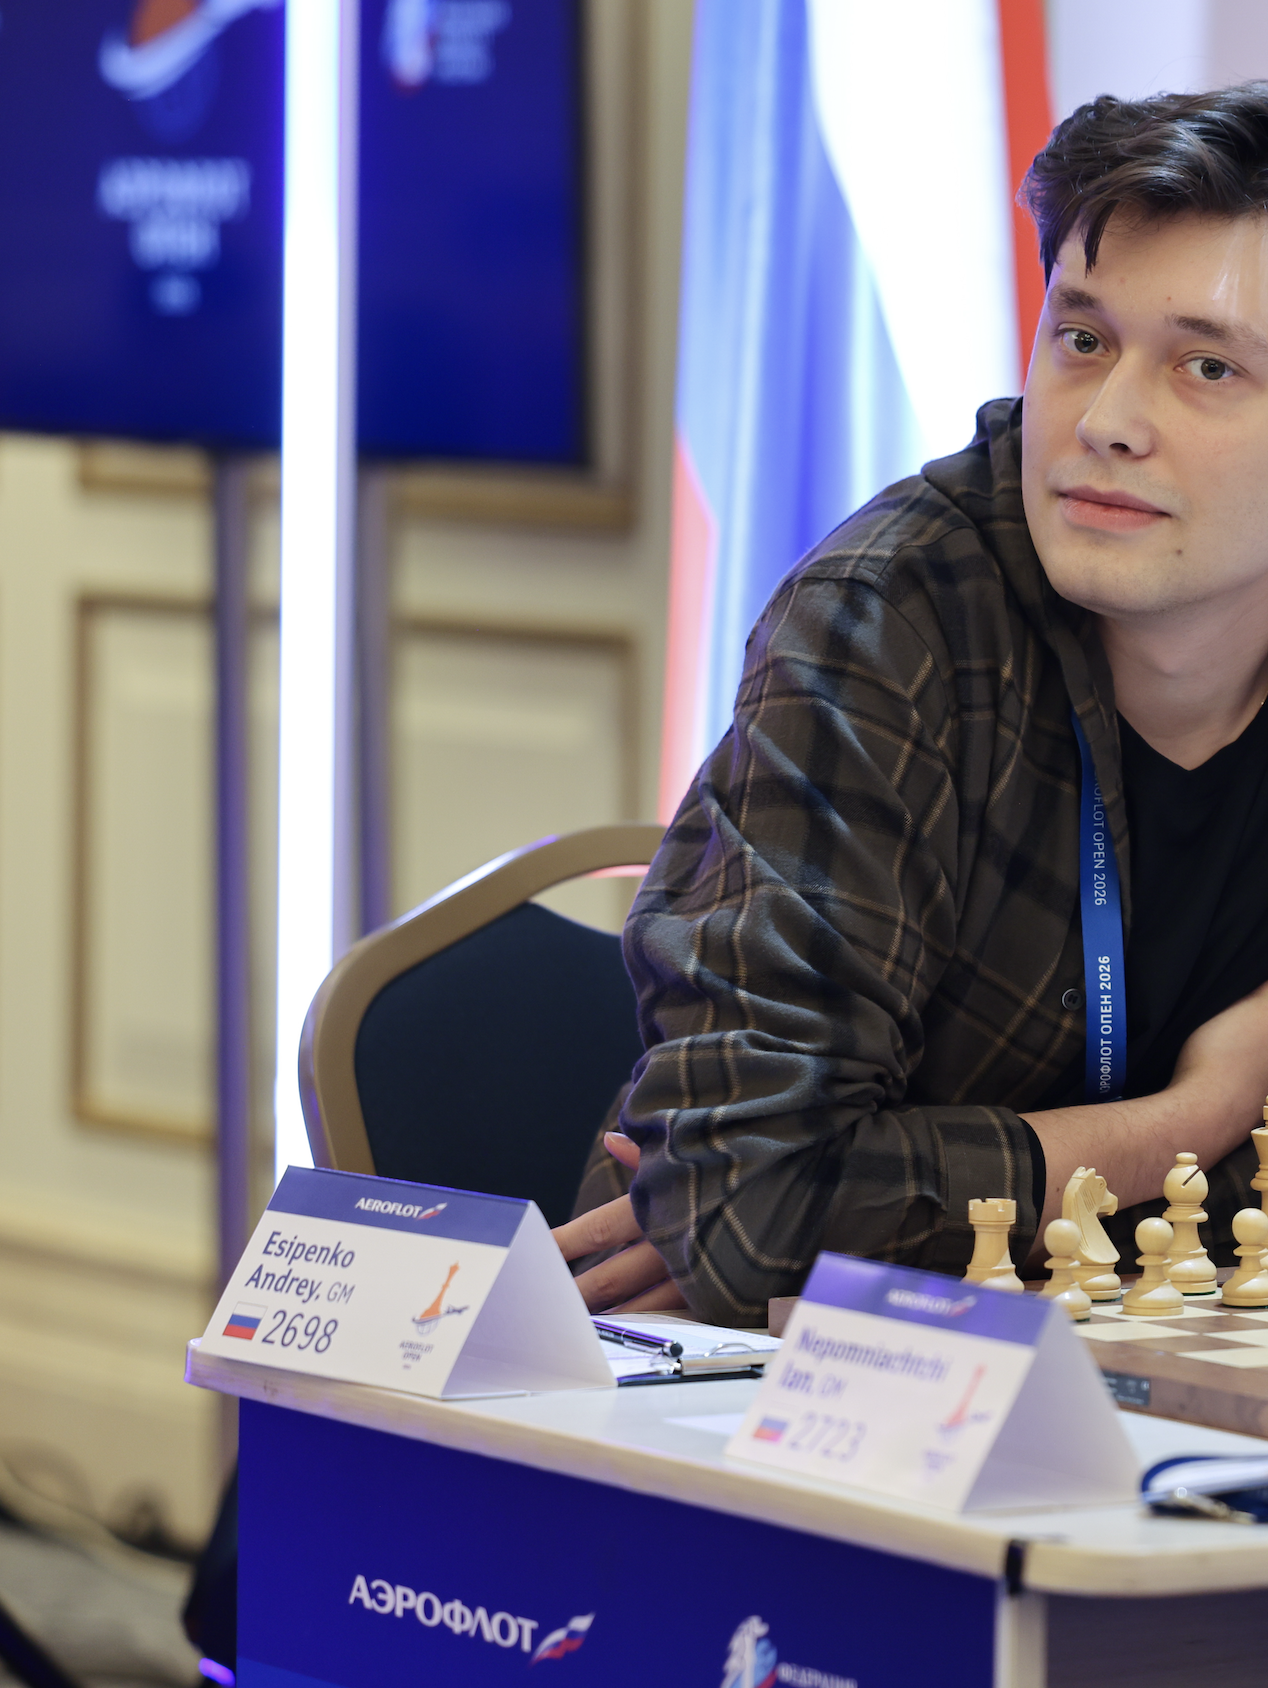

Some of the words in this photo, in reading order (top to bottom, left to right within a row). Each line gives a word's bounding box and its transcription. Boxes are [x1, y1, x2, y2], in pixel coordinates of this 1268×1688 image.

[1093, 832, 1105, 868] OPEN
[1094, 873, 1107, 906] 2026
[1098, 956, 1112, 990] 2026
[1100, 995, 1113, 1035] ОПЕН
[354, 1197, 423, 1219] AEROFLOT
[262, 1230, 356, 1269] Esipenko
[244, 1263, 323, 1304] Andrey,
[326, 1281, 356, 1305] GM
[261, 1309, 340, 1354] 2698
[349, 1574, 540, 1653] АЭРОФЛОТ
